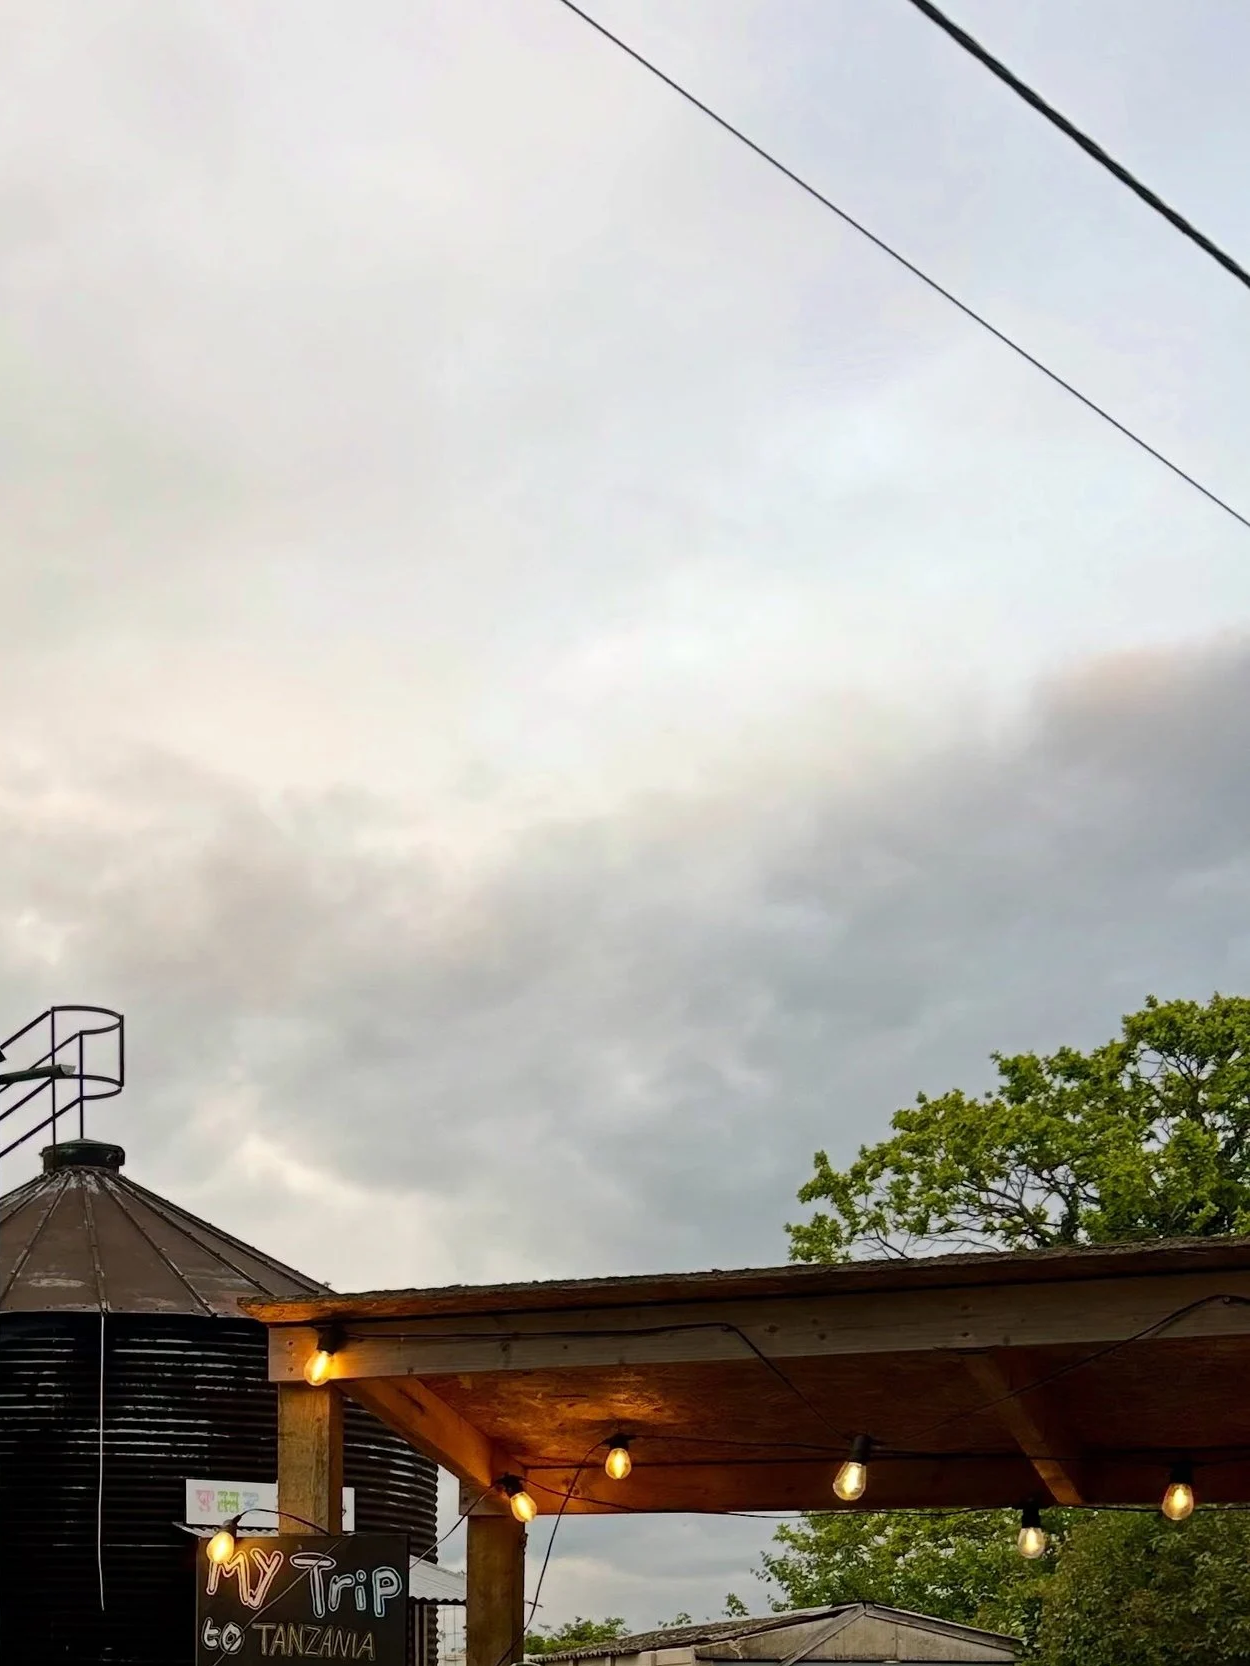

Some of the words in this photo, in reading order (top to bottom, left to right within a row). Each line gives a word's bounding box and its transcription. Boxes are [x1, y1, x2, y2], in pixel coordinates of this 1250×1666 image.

[289, 1551, 403, 1618] Trip
[201, 1617, 245, 1654] to
[251, 1622, 376, 1661] TANZANIA
